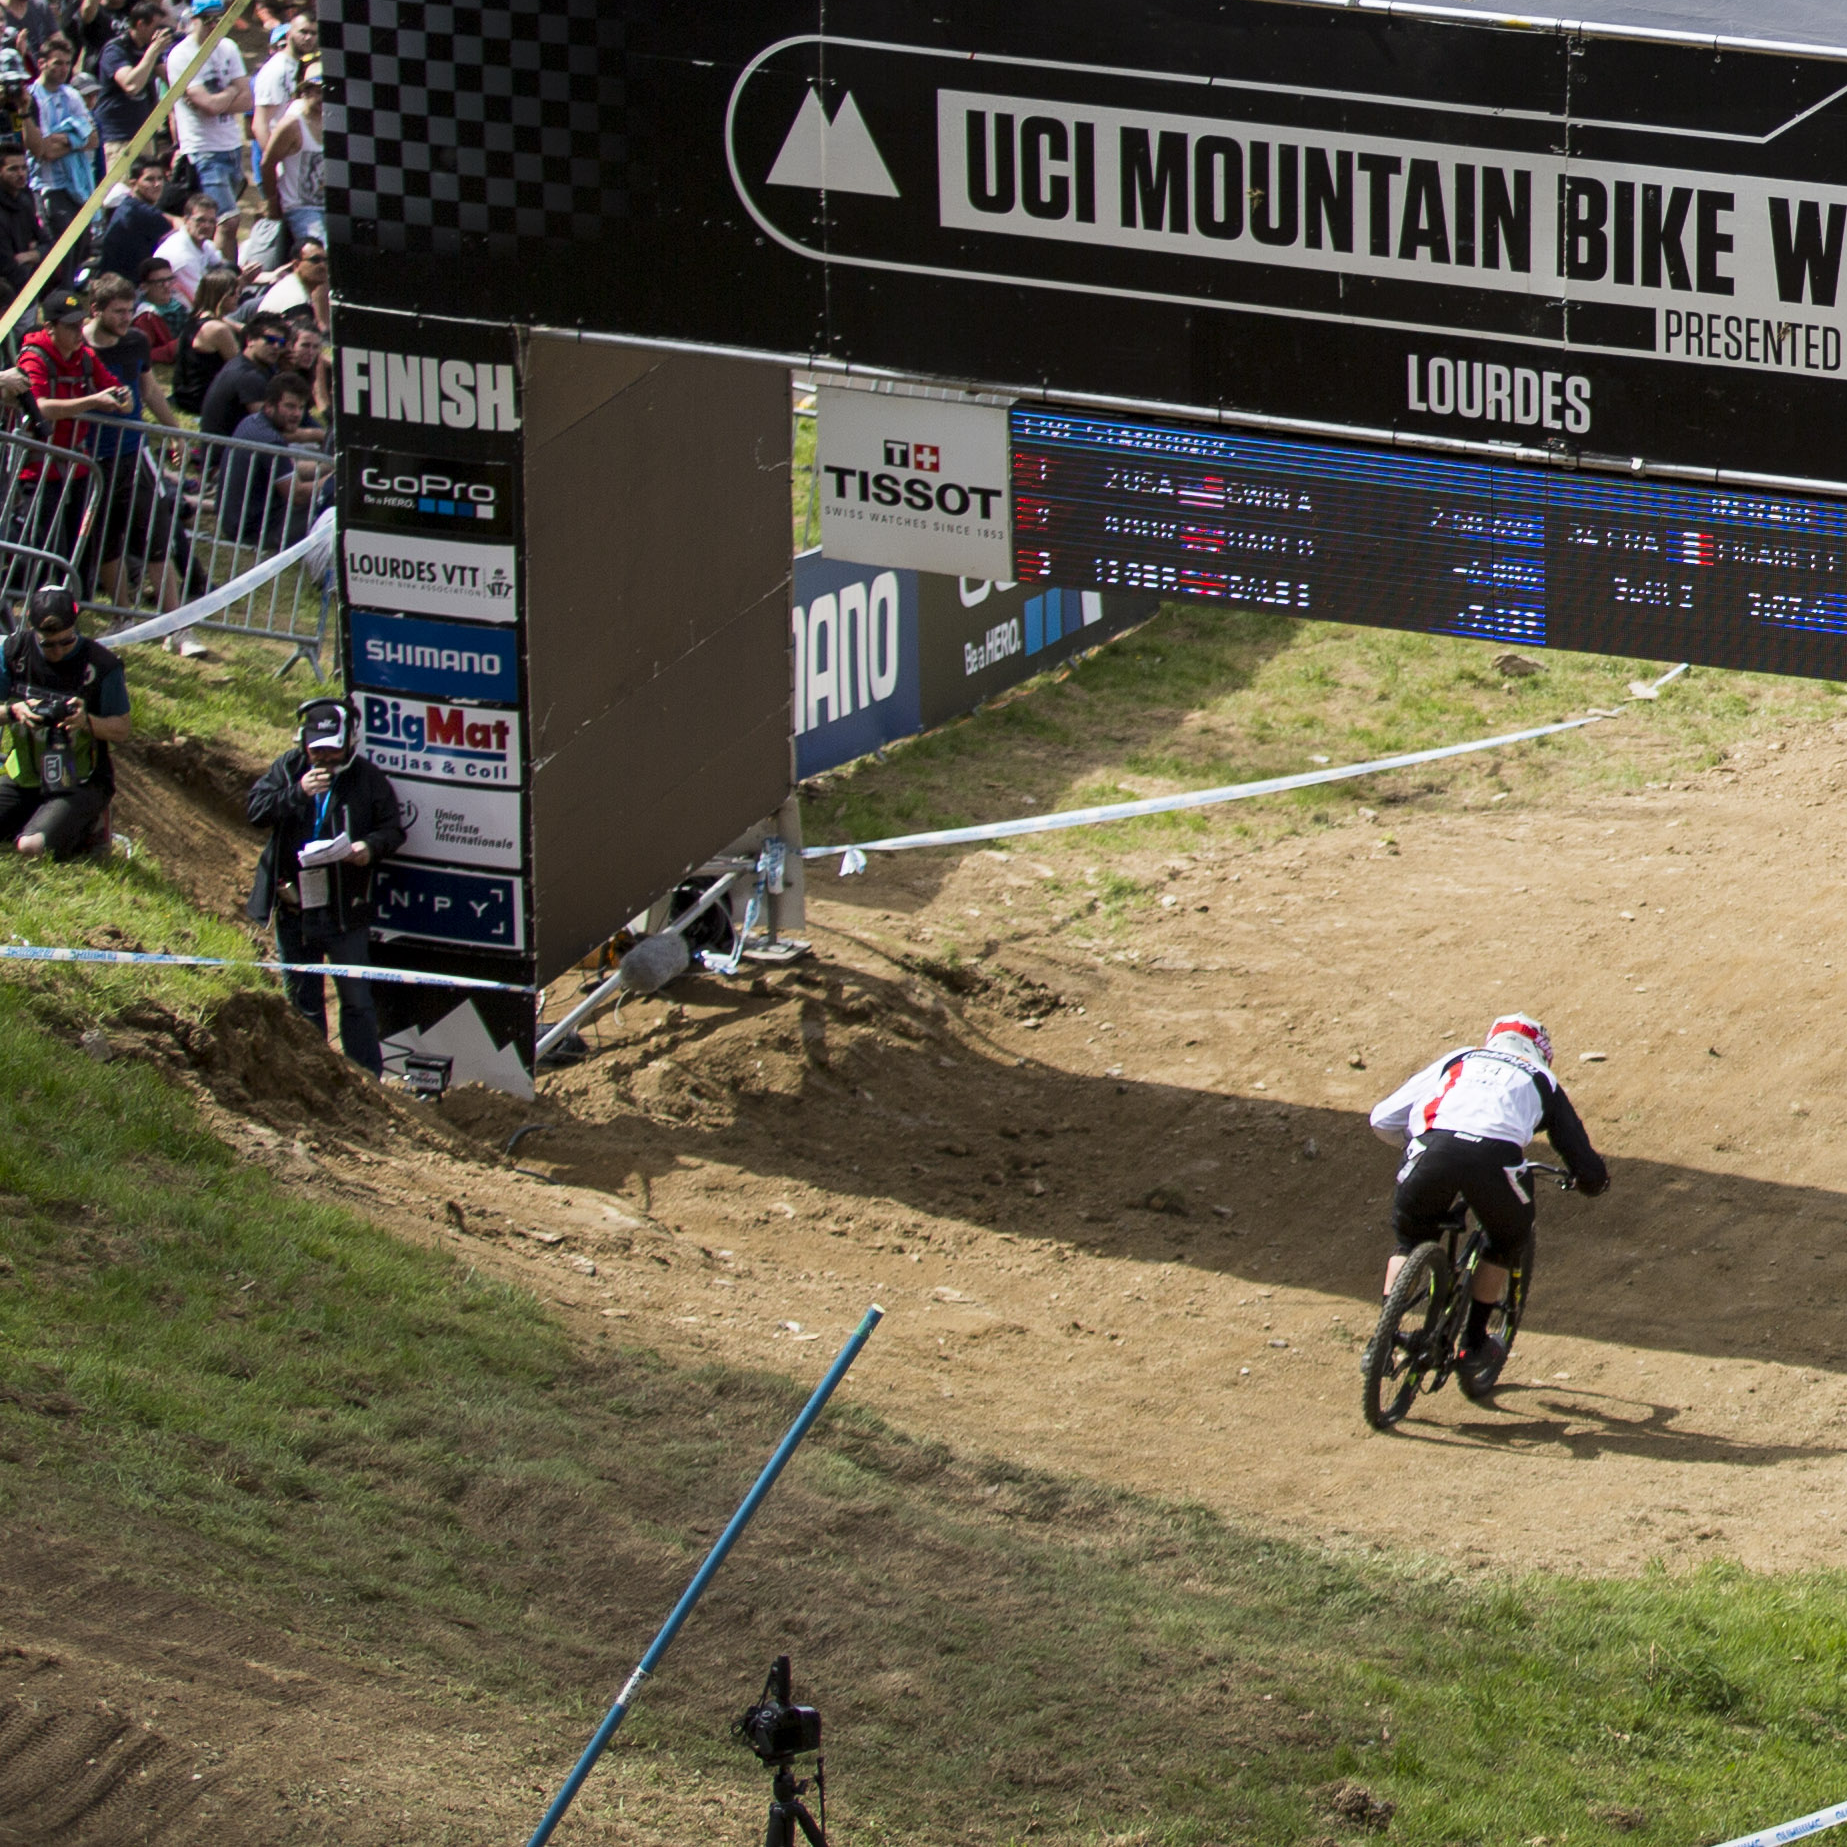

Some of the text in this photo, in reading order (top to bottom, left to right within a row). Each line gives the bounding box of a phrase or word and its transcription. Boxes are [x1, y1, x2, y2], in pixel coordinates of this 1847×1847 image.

[965, 108, 1097, 225] UCI
[1119, 125, 1532, 275] MOUNTAIN
[1558, 174, 1736, 297] BIKE
[1664, 308, 1842, 374] PRESENTED
[341, 346, 519, 432] FINISH
[1406, 353, 1591, 435] LOURDES
[362, 468, 496, 502] GoPro
[824, 465, 1003, 521] TISSOT
[824, 505, 1005, 540] SWISS WATCHES SINCE 1853
[349, 553, 480, 588] LOURDES VTT
[366, 638, 502, 676] SHIMANO
[987, 617, 1022, 665] HERO.
[364, 695, 510, 754] BigMat
[366, 749, 509, 781] Toujas & Coll
[434, 807, 465, 823] Union
[434, 819, 480, 835] Cycliste
[434, 832, 514, 851] Internationale
